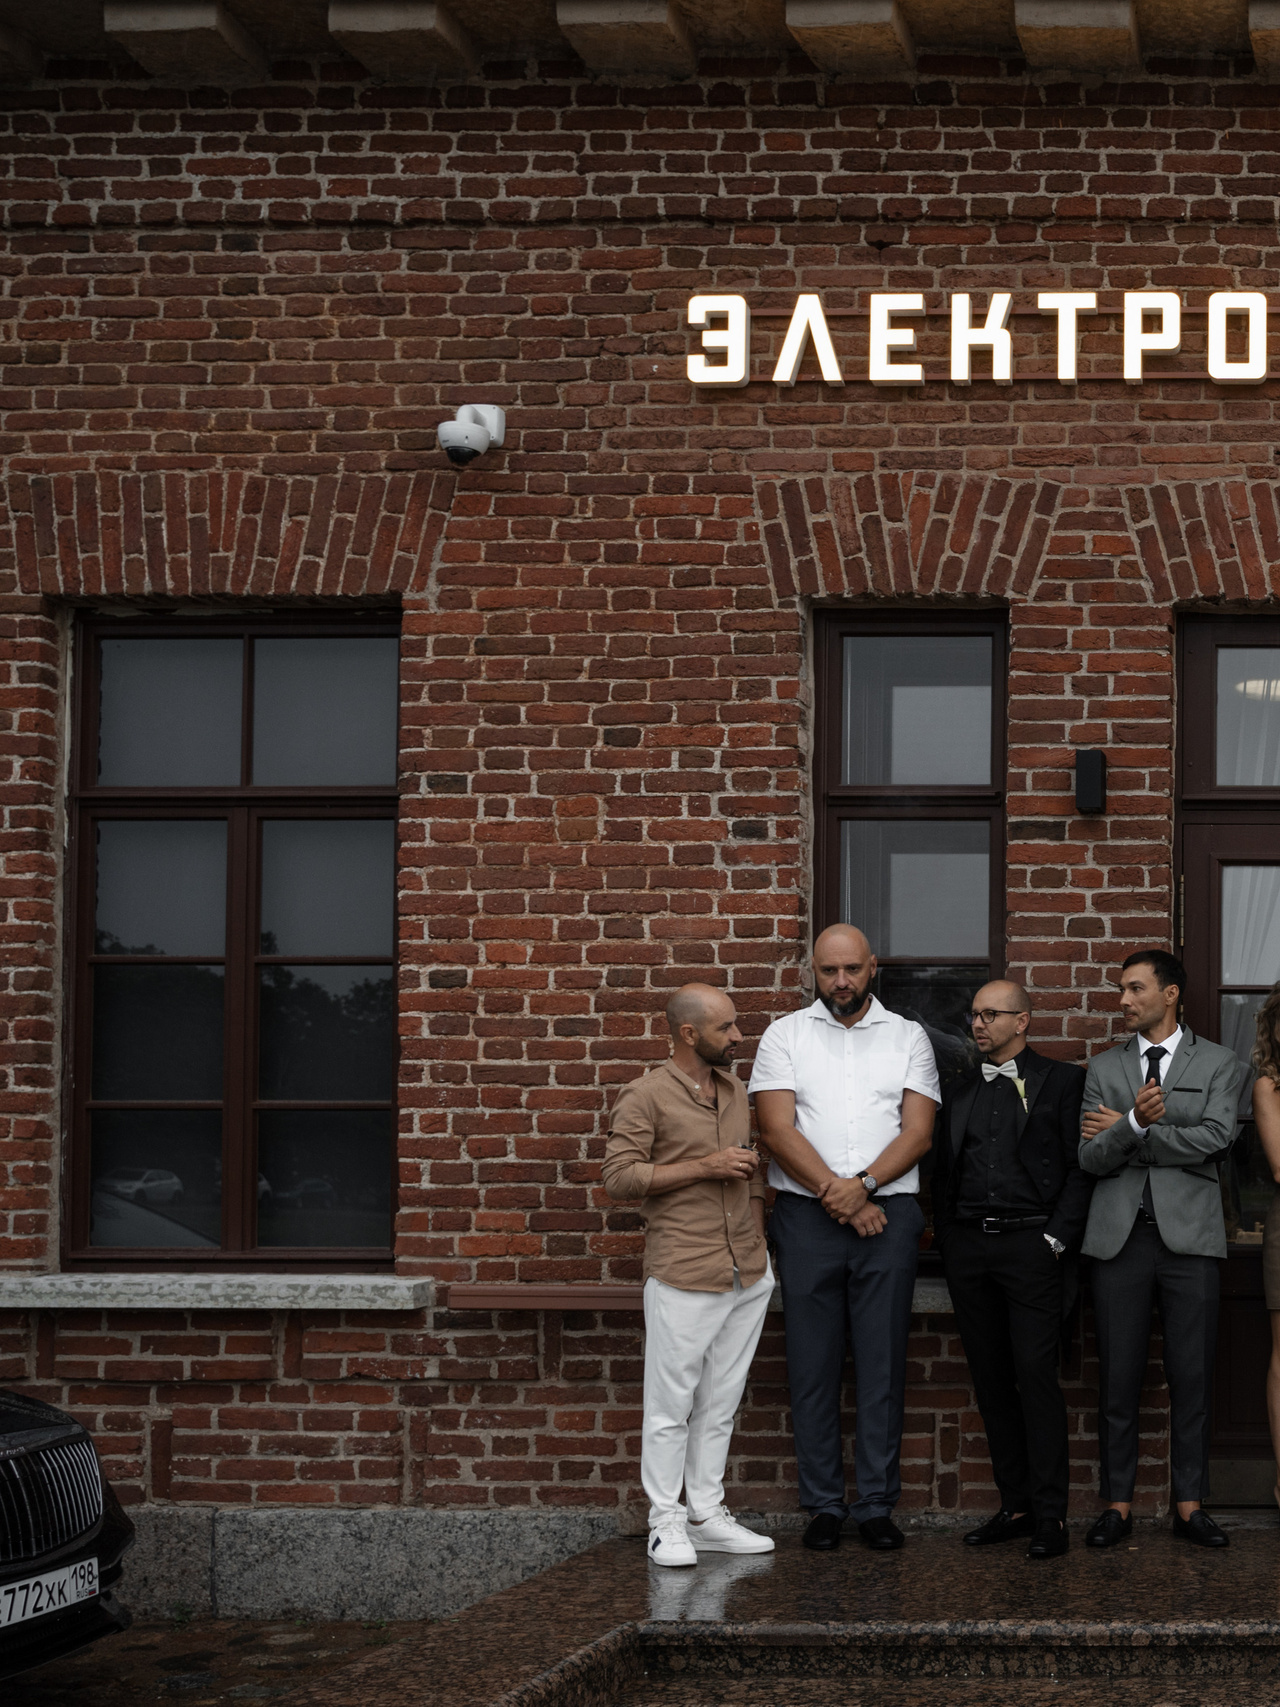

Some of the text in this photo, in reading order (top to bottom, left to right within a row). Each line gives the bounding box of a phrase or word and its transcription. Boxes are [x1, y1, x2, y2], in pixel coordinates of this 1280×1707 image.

[0, 1562, 94, 1625] 772ХК 198
[76, 1588, 88, 1599] RUS
